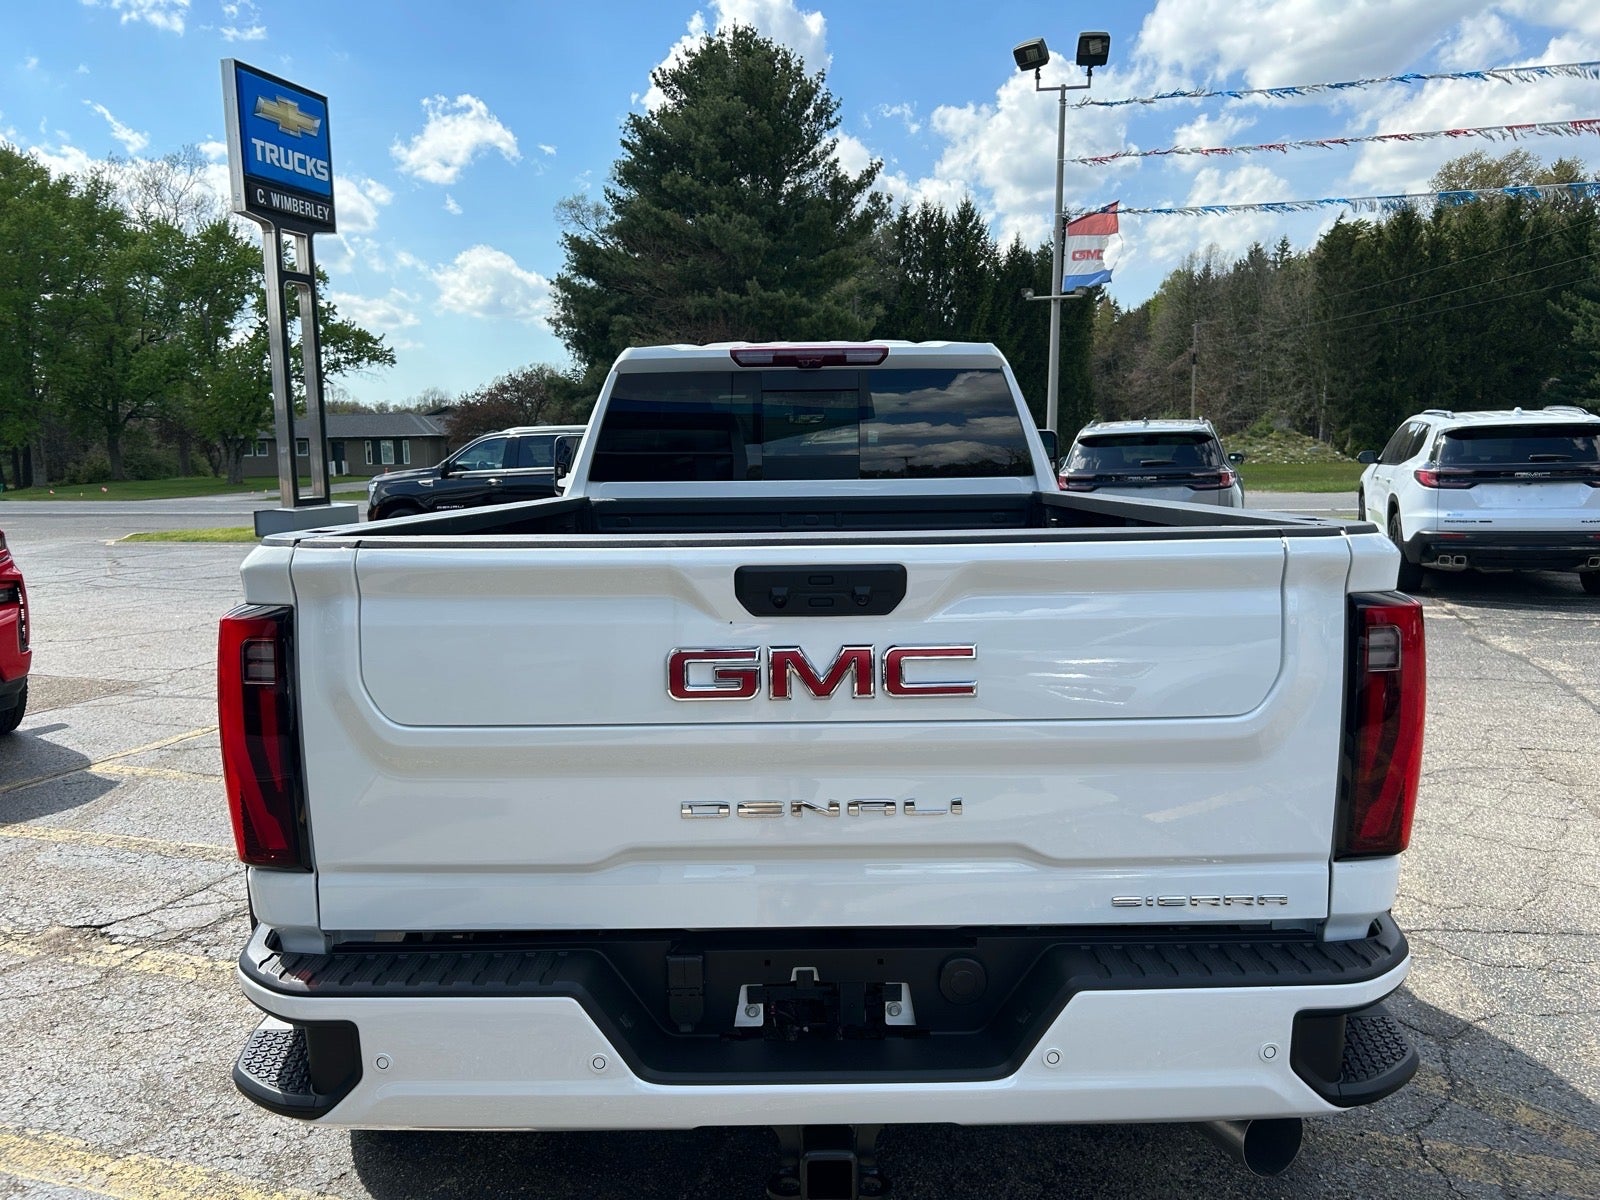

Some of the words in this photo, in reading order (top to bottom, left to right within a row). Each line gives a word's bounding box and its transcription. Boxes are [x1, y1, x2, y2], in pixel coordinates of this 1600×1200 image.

[251, 138, 328, 181] TRUCKS
[257, 189, 267, 205] C.
[270, 192, 330, 220] WIMBERLEY
[667, 643, 977, 701] GMC
[680, 797, 963, 819] DENALI
[1112, 895, 1288, 907] SIERRA
